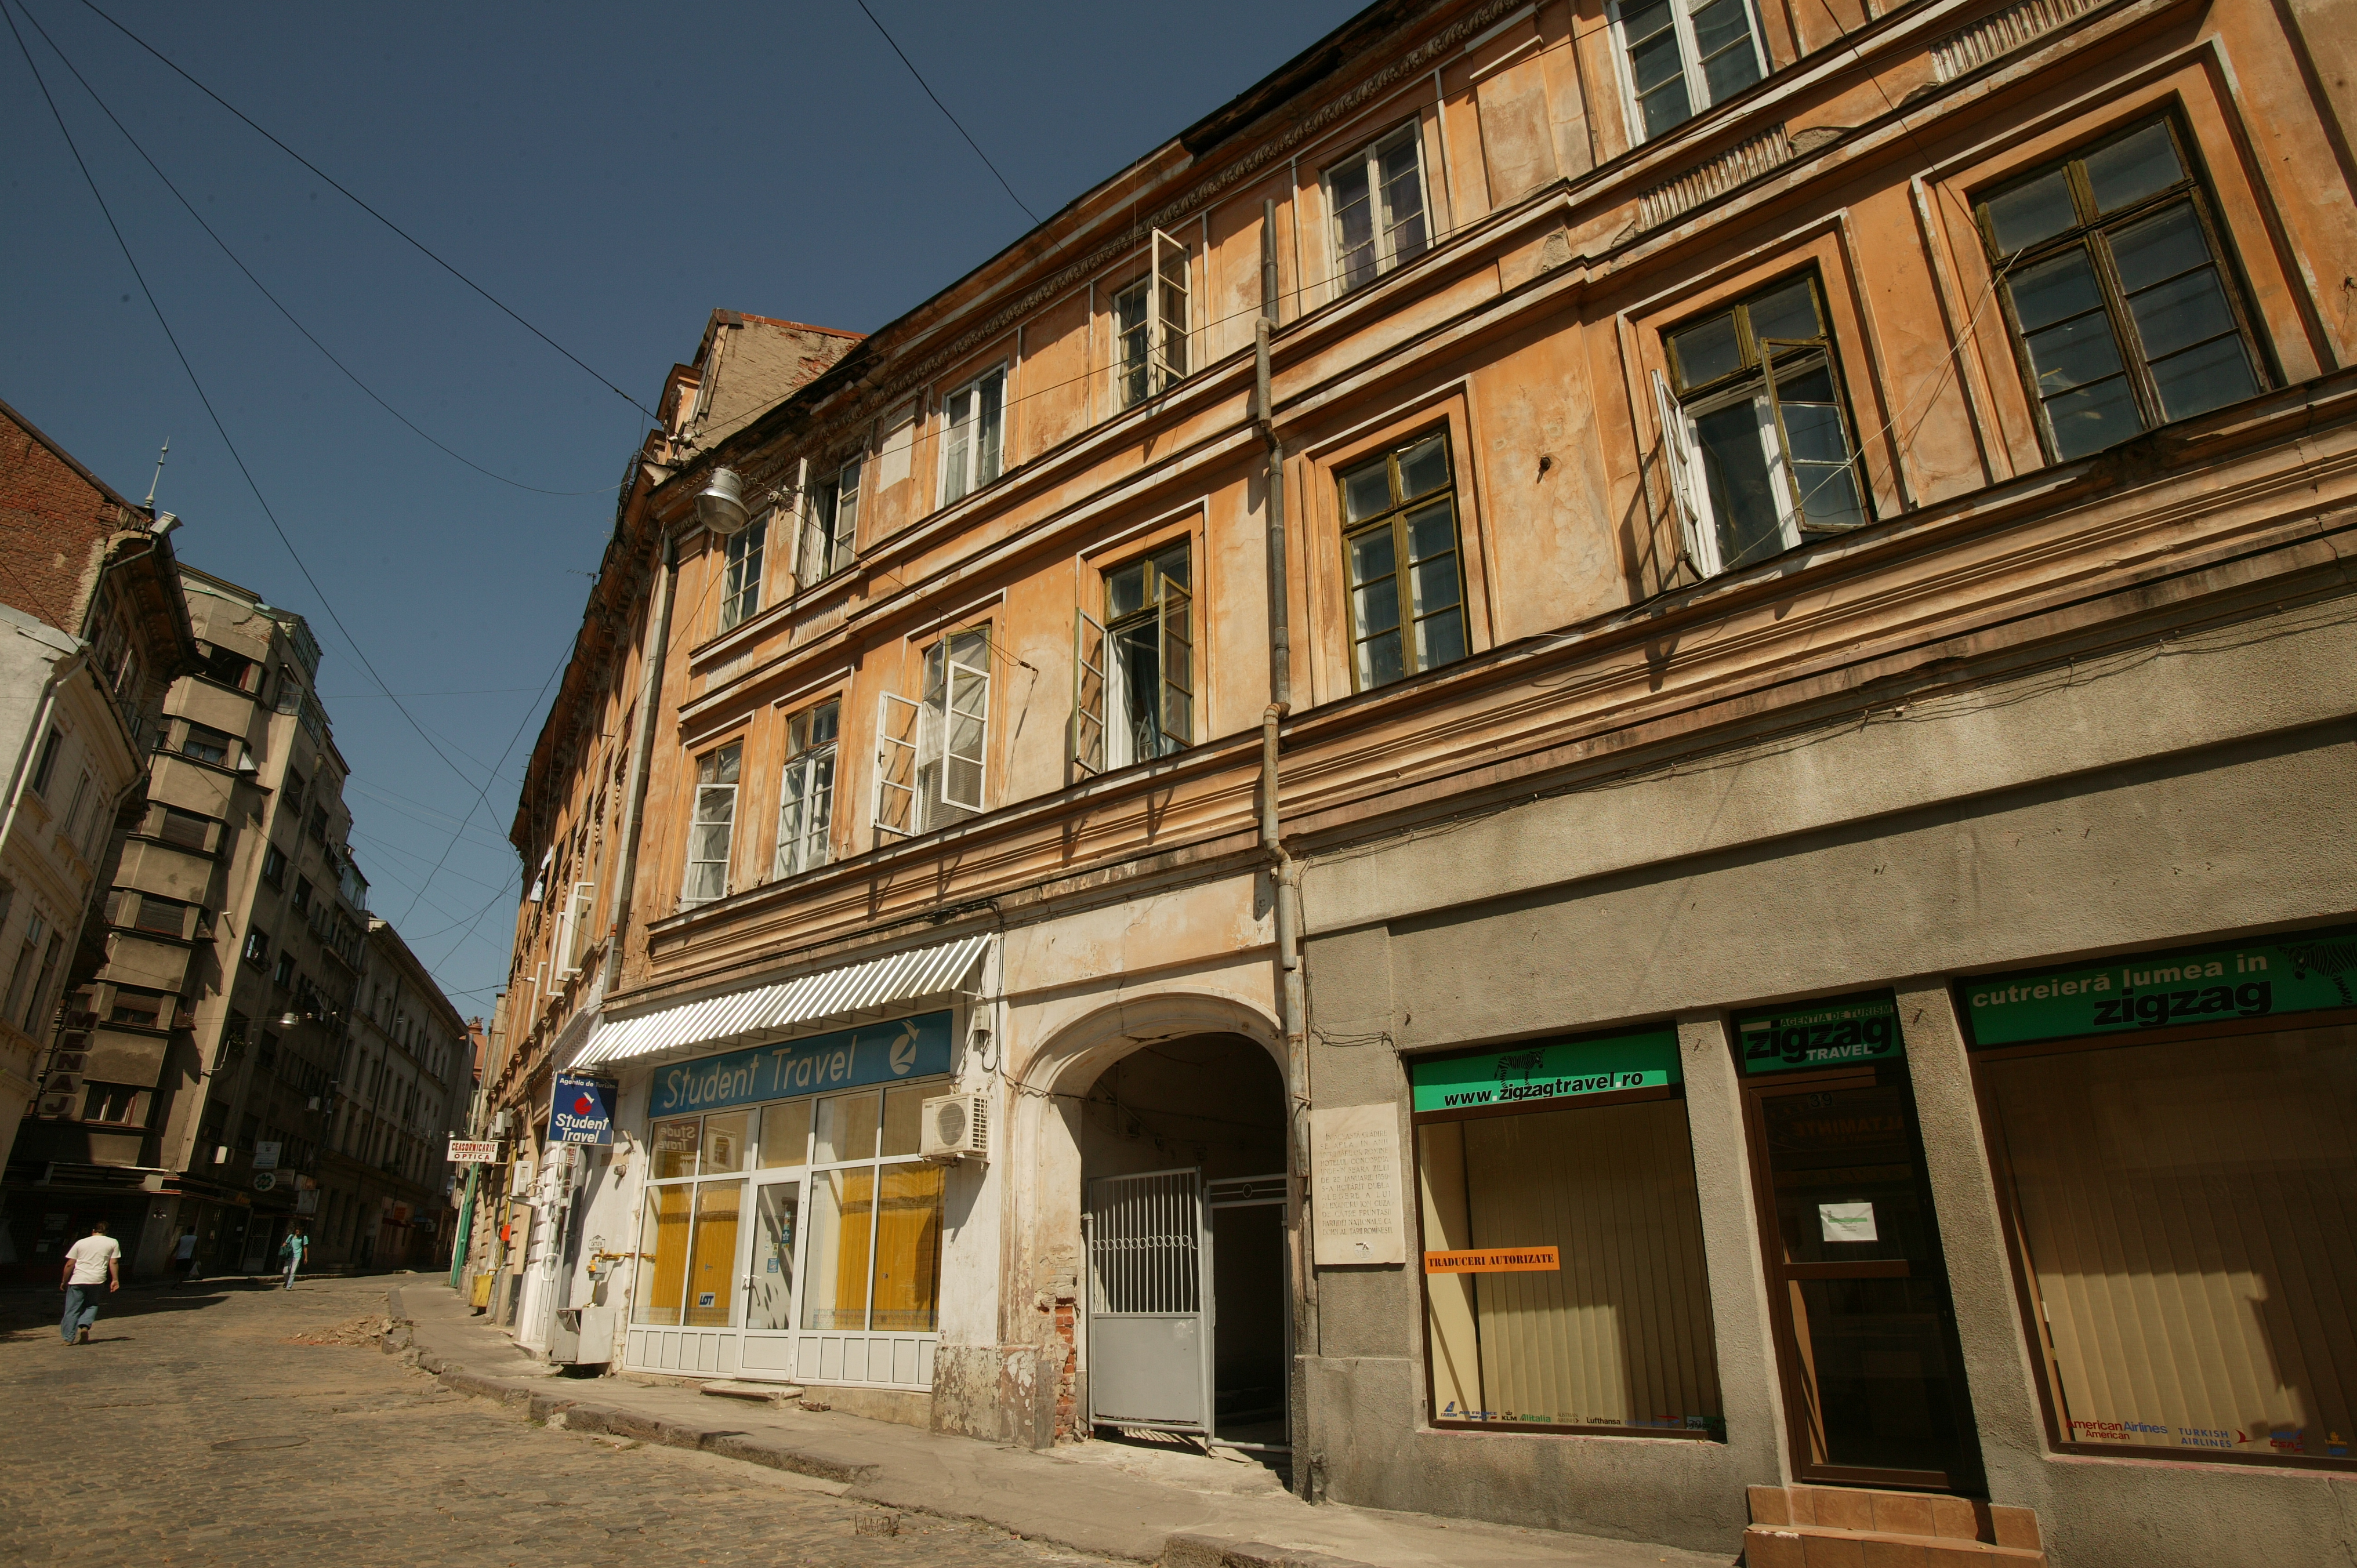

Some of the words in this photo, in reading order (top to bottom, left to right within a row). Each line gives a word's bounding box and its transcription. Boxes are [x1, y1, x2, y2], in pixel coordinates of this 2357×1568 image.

[1972, 972, 2111, 1008] cutreieră
[2122, 961, 2224, 988] lumea
[2236, 953, 2268, 974] in
[2093, 979, 2272, 1027] zigzag
[1781, 1013, 1827, 1027] AGENTIA
[1833, 1011, 1845, 1021] DE
[1849, 1005, 1891, 1018] TURISM
[1746, 1016, 1892, 1064] zigzag
[1806, 1043, 1873, 1061] TRAVEL
[45, 1010, 99, 1113] MENAJ
[663, 1054, 759, 1109] Student
[772, 1035, 857, 1091] Travel
[595, 1081, 615, 1090] Turism
[1444, 1071, 1644, 1106] www.zigzagtravel.ro
[1810, 1093, 1833, 1108] 39
[555, 1113, 610, 1131] Student
[562, 1127, 600, 1144] Travel
[451, 1142, 496, 1153] CEASORNICARIE
[1351, 1156, 1389, 1164] CONCORDIA
[1344, 1174, 1373, 1182] IANUARIE
[1322, 1192, 1359, 1200] ALEGERE
[1322, 1201, 1358, 1209] ALEXANDRU
[1428, 1256, 1486, 1267] TRADUCERI
[1488, 1253, 1554, 1265] AUTORIZATE
[699, 1295, 714, 1305] LOT
[1520, 1413, 1551, 1422] Alitalia
[1586, 1417, 1620, 1425] Lufthansa
[2066, 1420, 2123, 1432] American
[2123, 1421, 2168, 1434] Airlines
[2178, 1428, 2228, 1438] TURKISH
[2086, 1429, 2130, 1440] American
[2181, 1437, 2232, 1448] AIRLINES
